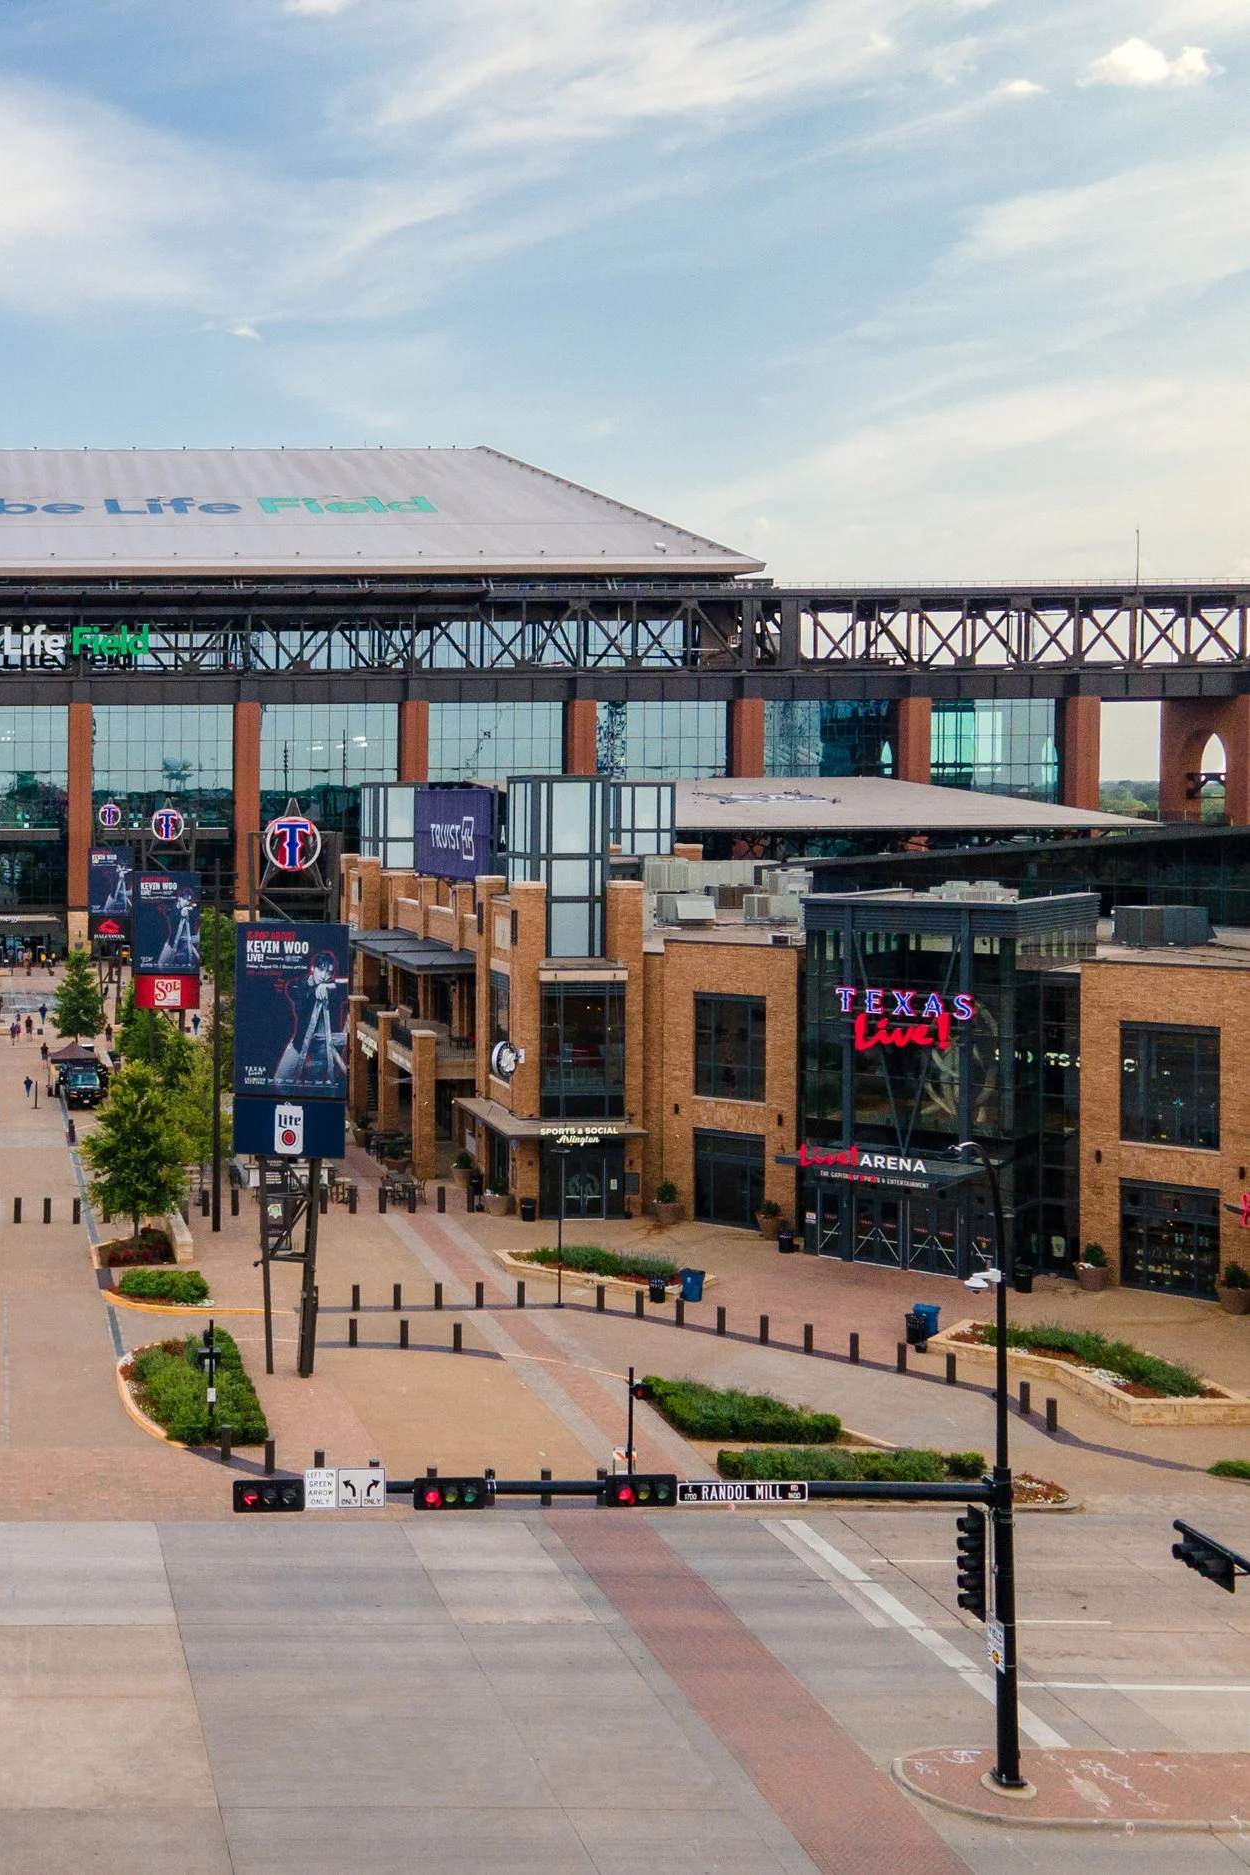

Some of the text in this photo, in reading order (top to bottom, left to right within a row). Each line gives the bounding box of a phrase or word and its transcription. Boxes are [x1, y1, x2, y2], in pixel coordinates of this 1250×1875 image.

[104, 496, 242, 516] Life
[257, 495, 439, 515] Field
[3, 624, 65, 656] Life
[72, 624, 150, 656] Field
[430, 823, 461, 850] TRUIST
[140, 882, 177, 890] KEVIN WOO
[246, 940, 309, 954] KEVIN WOO
[246, 953, 264, 962] LIVE!
[835, 985, 975, 1021] TEXAS
[854, 1013, 950, 1051] Live!
[278, 1114, 301, 1129] Lite
[540, 1126, 619, 1136] SPORTS & SOCIAL
[556, 1134, 600, 1147] Arlington
[799, 1143, 927, 1174] Live! ARENA
[820, 1169, 830, 1177] THE
[886, 1178, 930, 1189] ENTERTAINMENT
[307, 1471, 334, 1479] LEFT ON
[309, 1480, 332, 1488] GREEN
[307, 1489, 333, 1497] ARROW
[701, 1484, 783, 1500] RANDOL MILL
[310, 1498, 330, 1506] ONLY
[341, 1498, 359, 1506] ONLY
